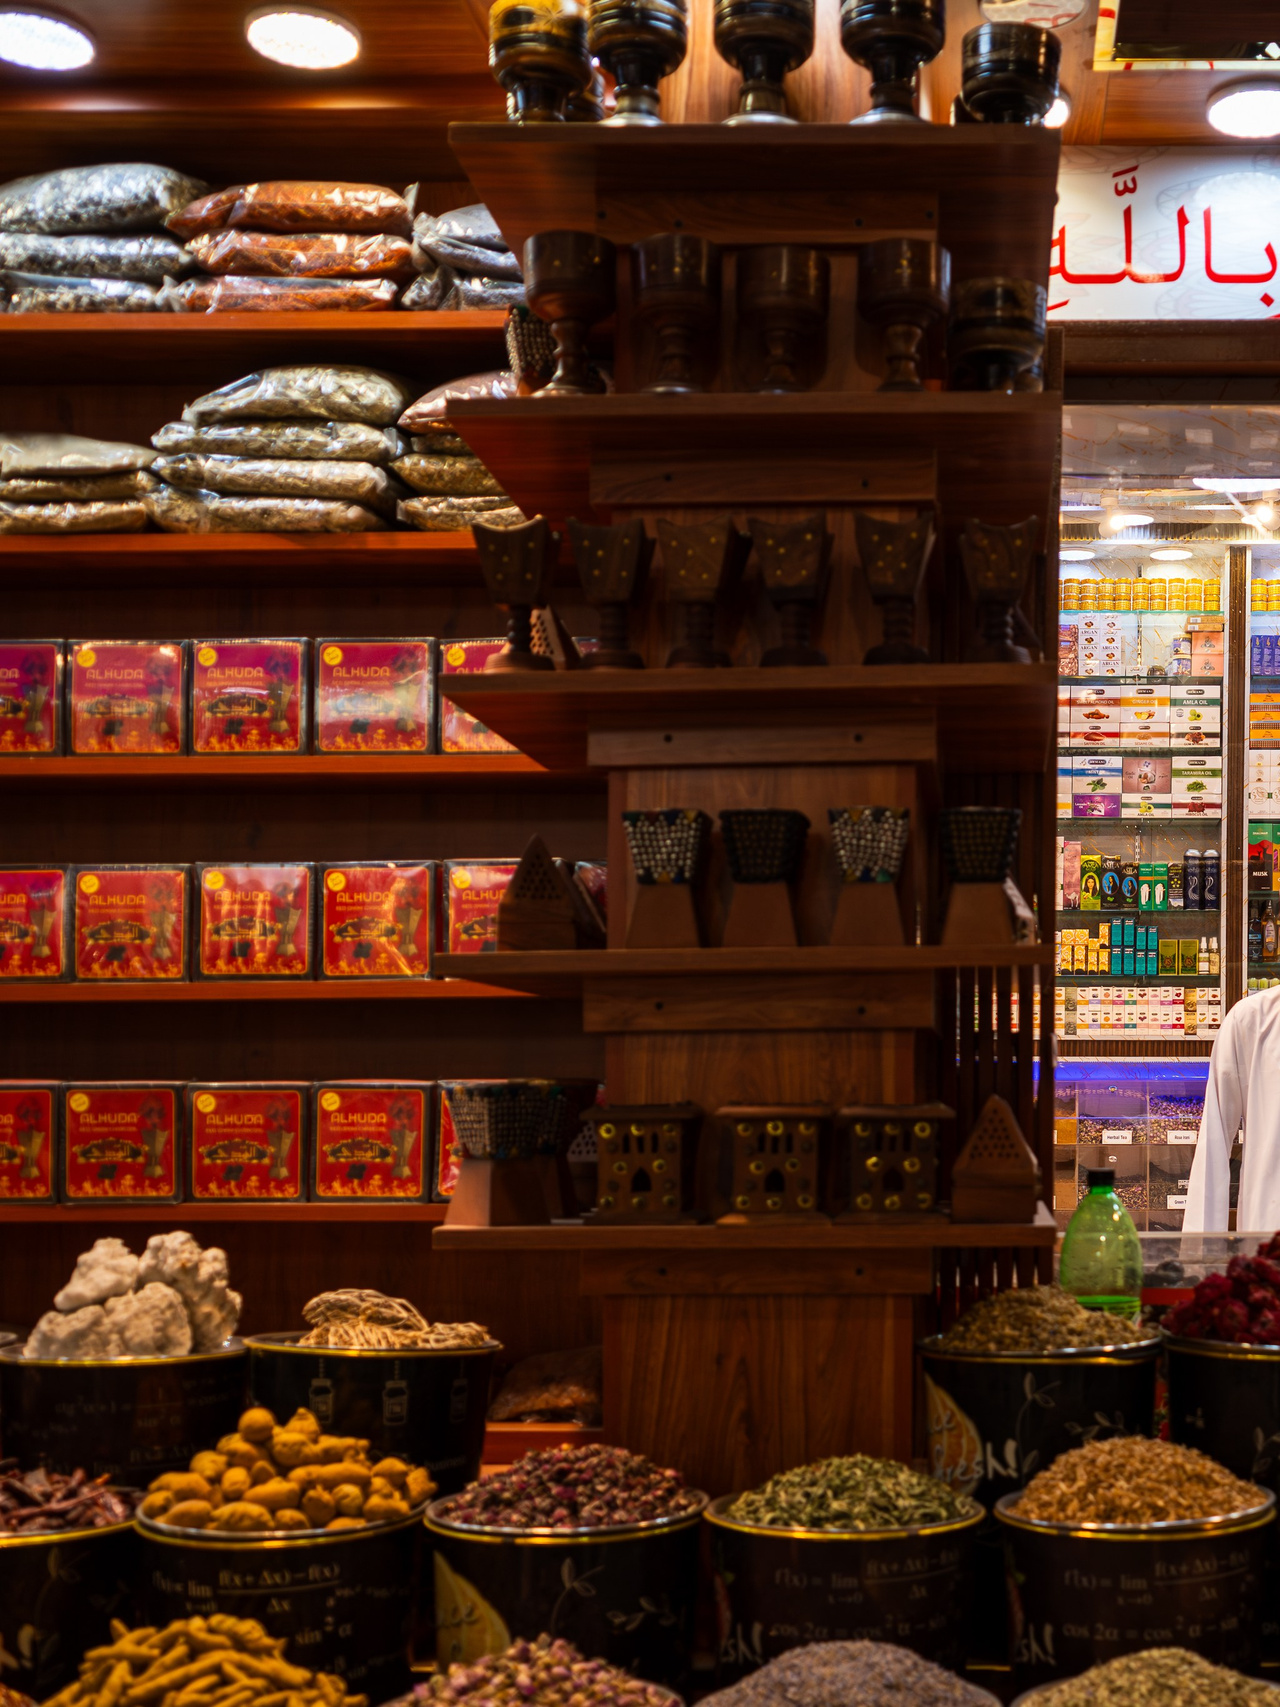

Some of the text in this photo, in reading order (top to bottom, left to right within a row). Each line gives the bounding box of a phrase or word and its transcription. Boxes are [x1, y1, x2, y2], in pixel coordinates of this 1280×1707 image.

[86, 668, 144, 680] ALHUDA
[207, 666, 264, 678] ALHUDA
[332, 666, 390, 678] ALHUDA
[89, 893, 146, 906] ALHUDA
[214, 890, 271, 902] ALHUDA
[336, 891, 392, 902] ALHUDA
[80, 1112, 138, 1124] ALHUDA
[206, 1113, 264, 1125] ALHUDA
[330, 1112, 386, 1124] ALHUDA
